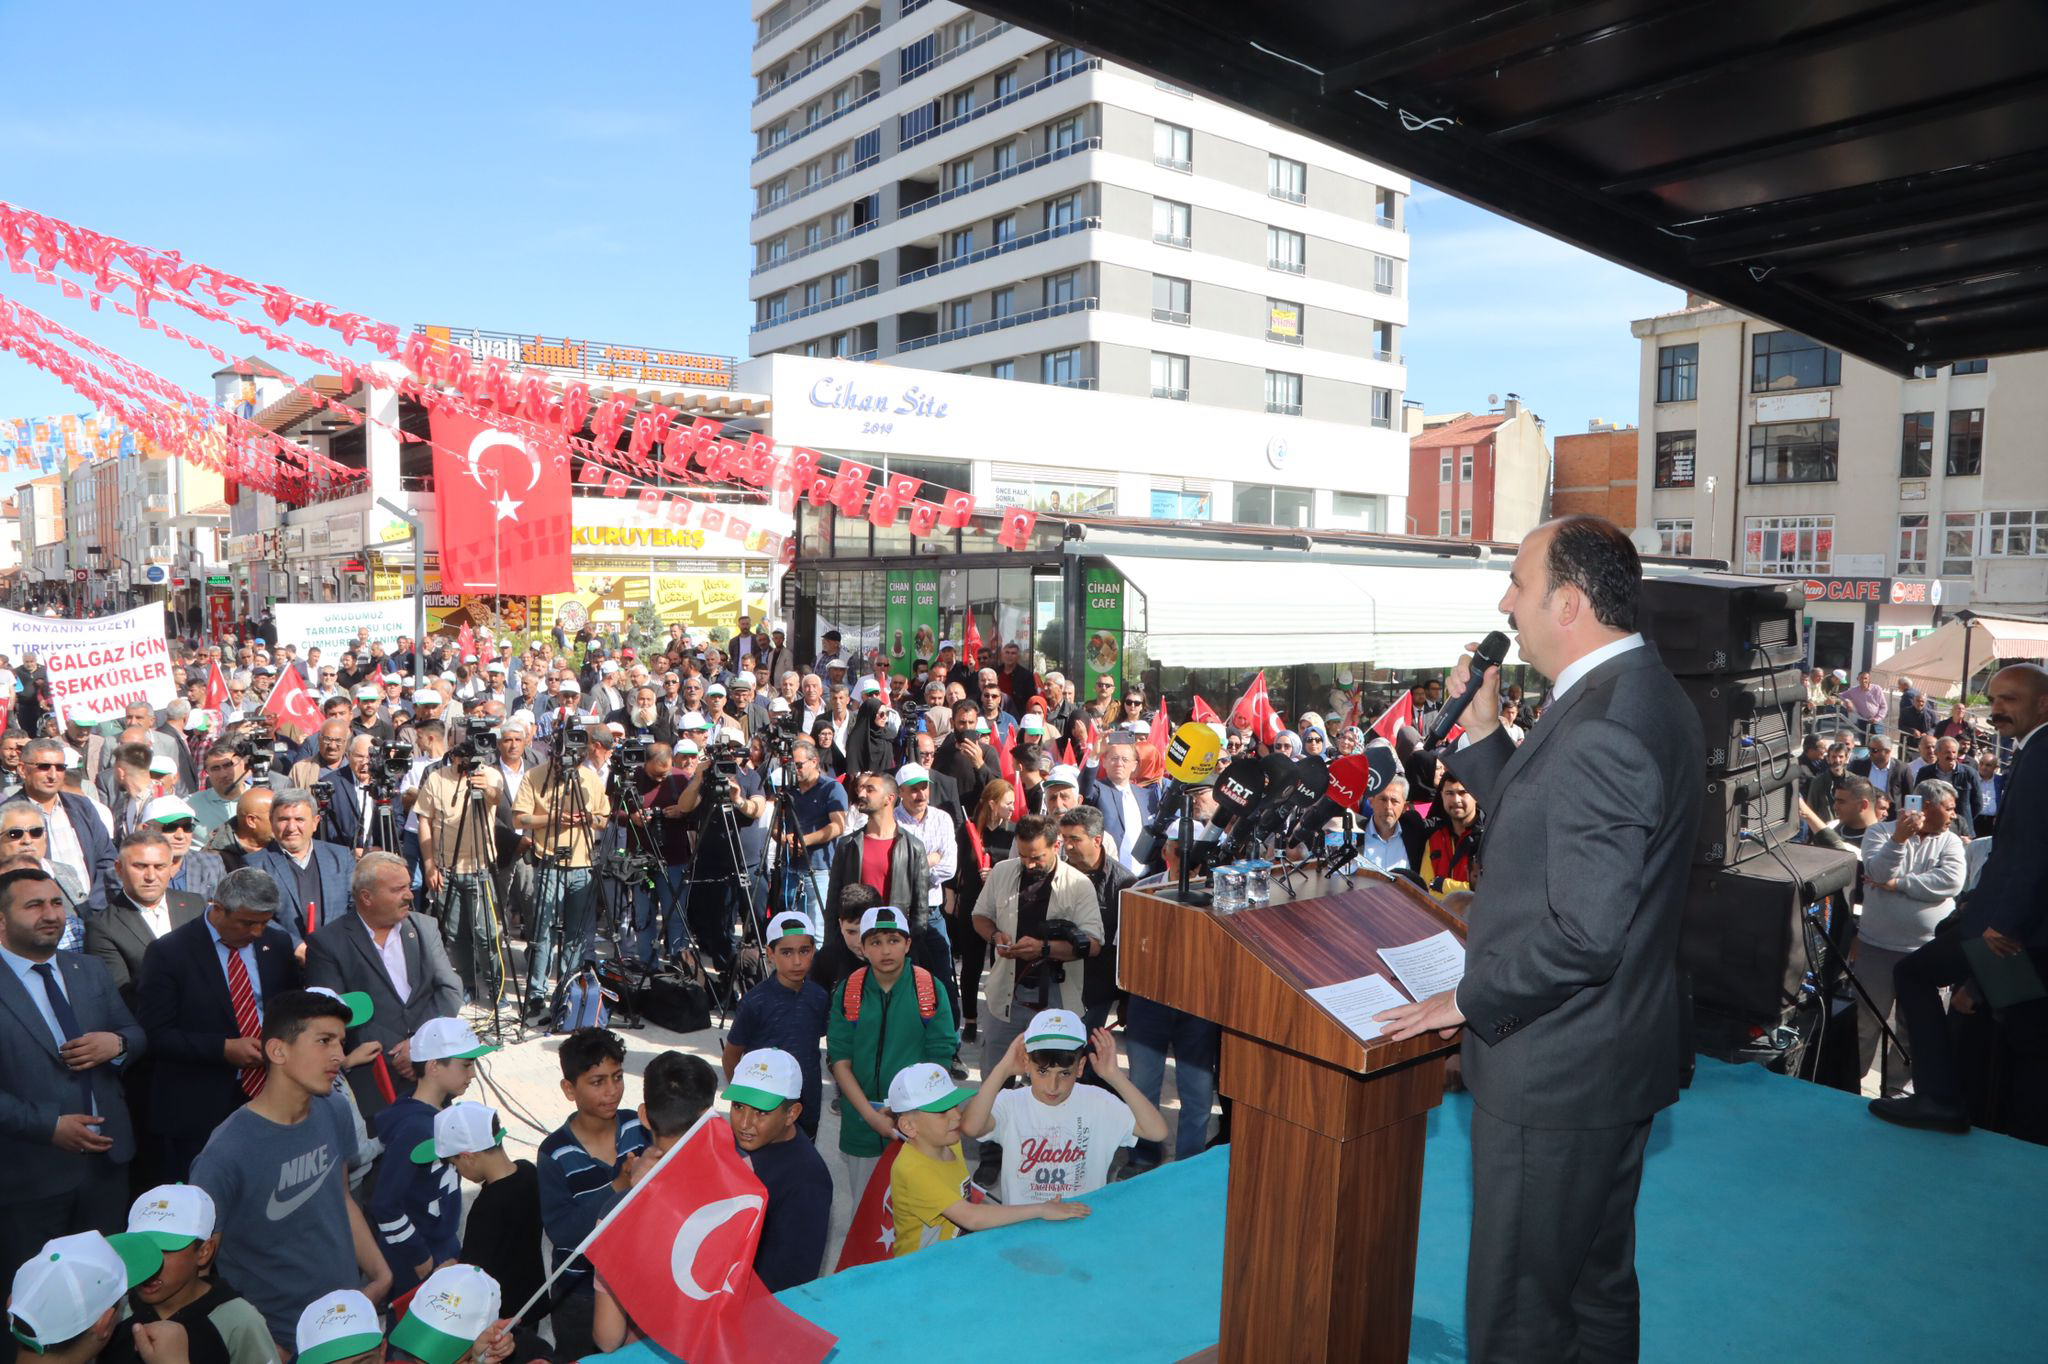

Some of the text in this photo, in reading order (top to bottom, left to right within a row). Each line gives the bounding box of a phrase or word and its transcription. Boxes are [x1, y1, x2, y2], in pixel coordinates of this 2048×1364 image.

[597, 363, 731, 386] CAFE RESTAURANT
[809, 377, 948, 418] Cihan Site
[1087, 581, 1120, 594] CİHAN
[1828, 581, 1881, 600] CAFE
[423, 594, 460, 606] RUYEMİŞ
[891, 595, 907, 604] CAFE
[917, 596, 934, 605] CAFE
[1091, 599, 1116, 609] CAFE
[130, 636, 166, 662] İÇİN
[48, 662, 167, 700] EŞEKKÜRLER
[1220, 784, 1248, 807] HABER
[1227, 777, 1254, 799] TRT
[278, 1144, 328, 1192] NIKE
[424, 1294, 462, 1320] Konya
[316, 1312, 357, 1329] Konya
